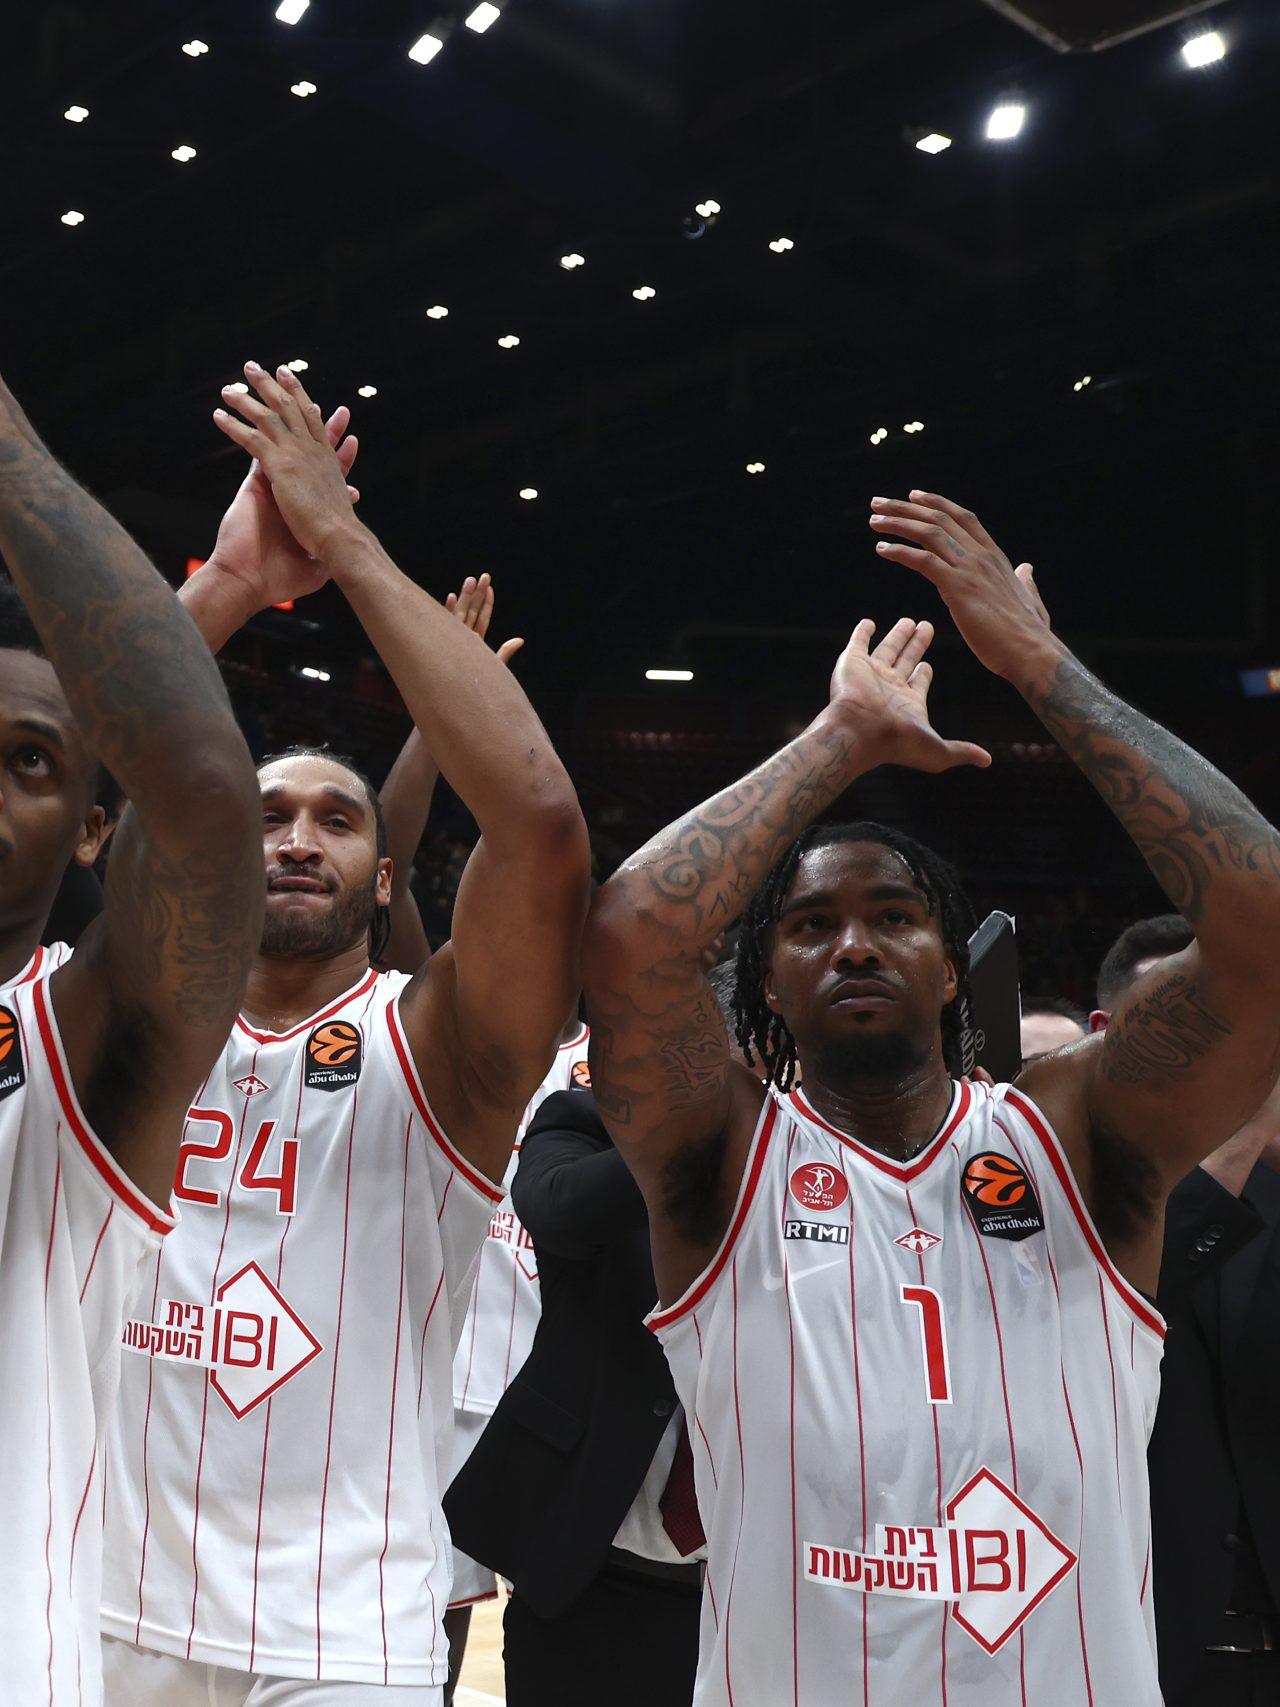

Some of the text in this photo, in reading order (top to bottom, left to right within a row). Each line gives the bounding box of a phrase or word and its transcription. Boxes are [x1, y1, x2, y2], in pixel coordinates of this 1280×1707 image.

[308, 1072, 358, 1084] abu dhabi
[173, 1108, 298, 1213] 24
[786, 1221, 847, 1243] RTMI
[983, 1217, 1040, 1231] abu dhabi
[165, 1301, 204, 1331] בית
[122, 1321, 202, 1360] השקעות
[211, 1308, 278, 1371] IBI
[903, 1287, 948, 1400] 1
[884, 1526, 937, 1557] בית
[948, 1529, 1026, 1593] IBI
[808, 1546, 938, 1592] השקעות
